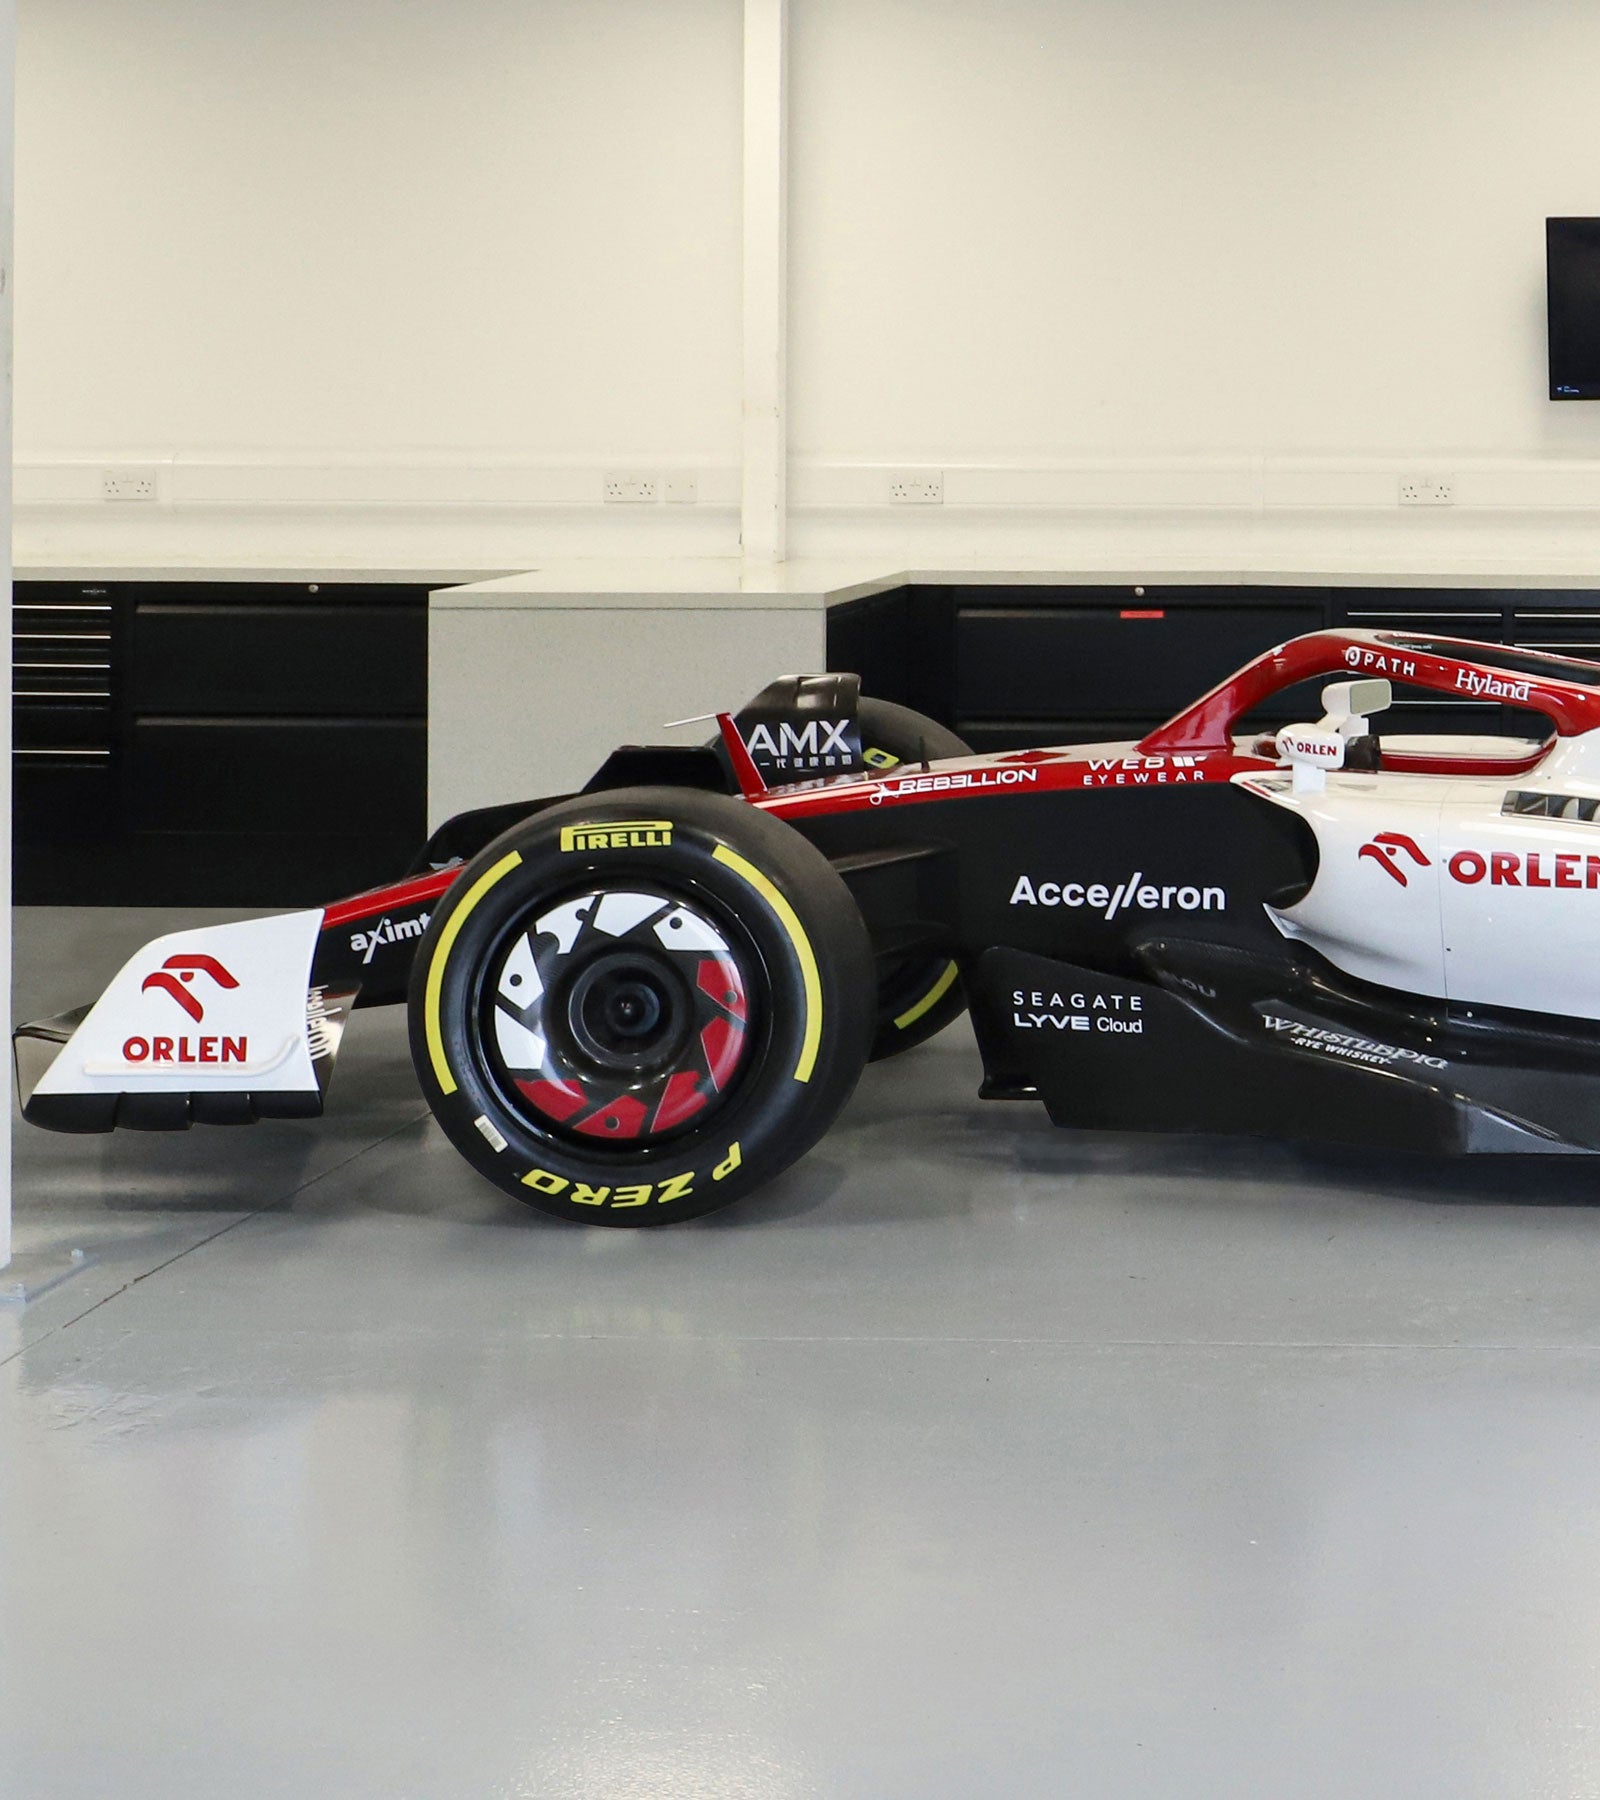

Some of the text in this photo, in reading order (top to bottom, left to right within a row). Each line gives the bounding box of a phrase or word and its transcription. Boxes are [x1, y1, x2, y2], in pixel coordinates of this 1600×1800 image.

[1363, 652, 1416, 676] PATH
[1455, 668, 1530, 702] Hyland
[746, 719, 851, 756] AMX
[1297, 742, 1337, 756] ORLEN
[1088, 758, 1165, 771] WEB
[1083, 770, 1204, 786] EYEWEAR
[559, 821, 674, 852] PIRELLI
[1013, 991, 1143, 1011] SEAGATE
[1014, 1013, 1143, 1034] LYVE Cloud
[122, 1036, 248, 1063] ORLEN
[520, 1141, 743, 1209] P ZERO
